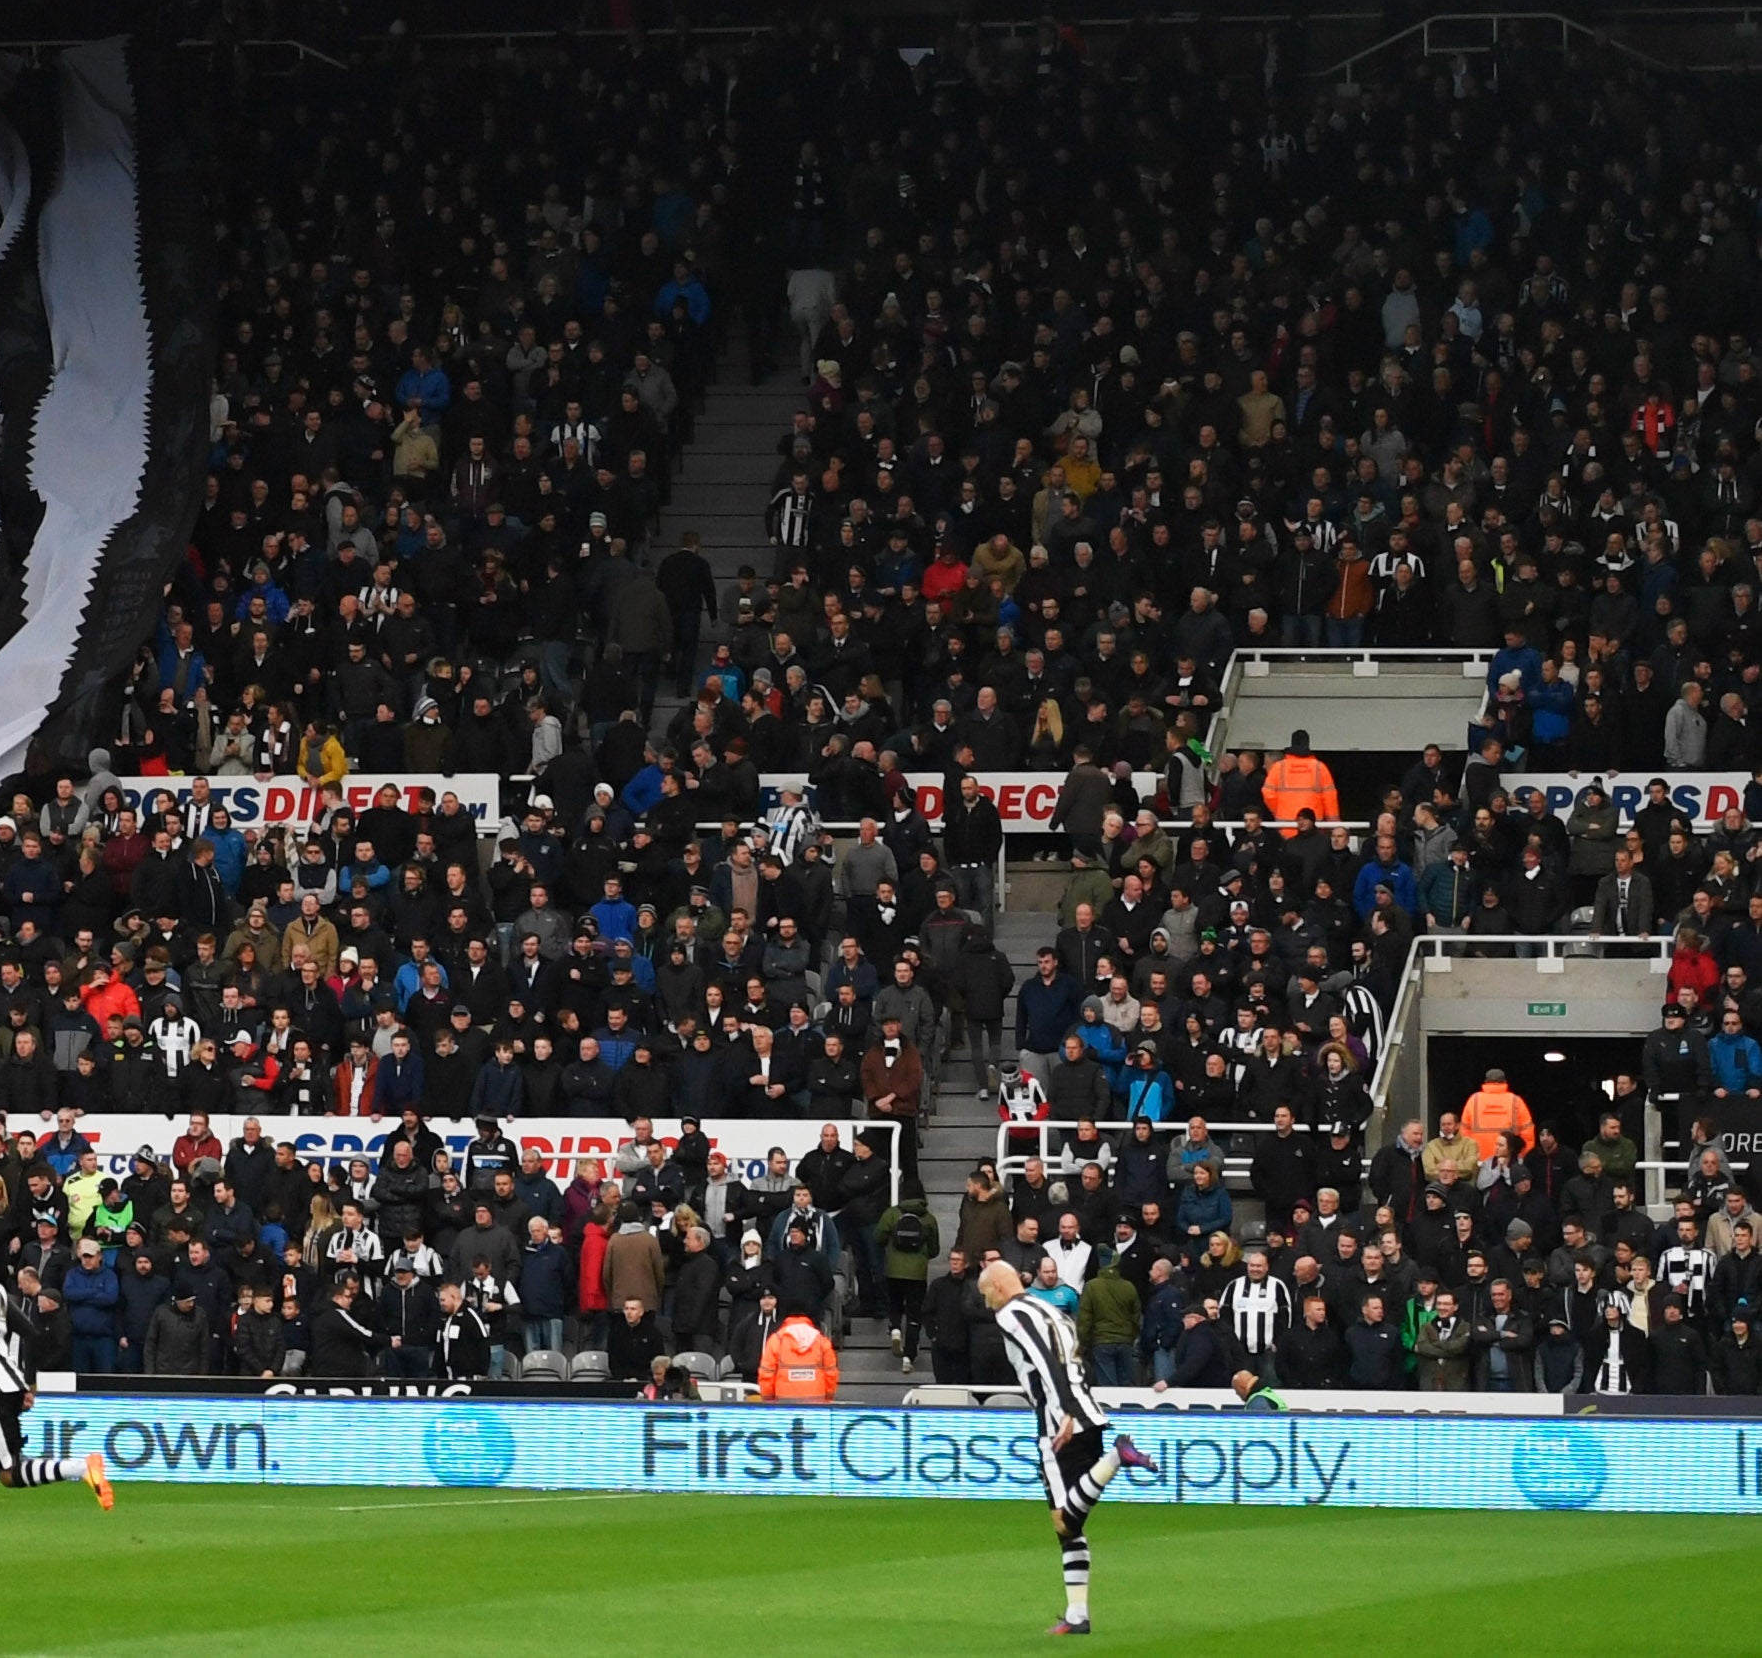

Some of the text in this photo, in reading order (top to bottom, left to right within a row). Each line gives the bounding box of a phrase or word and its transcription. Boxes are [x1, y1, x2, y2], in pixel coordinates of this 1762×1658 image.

[1533, 1004, 1550, 1014] Exit
[1722, 1132, 1762, 1153] ORE
[104, 1420, 280, 1472] own.
[643, 1411, 1358, 1504] First Class upply.
[1736, 1429, 1762, 1497] I
